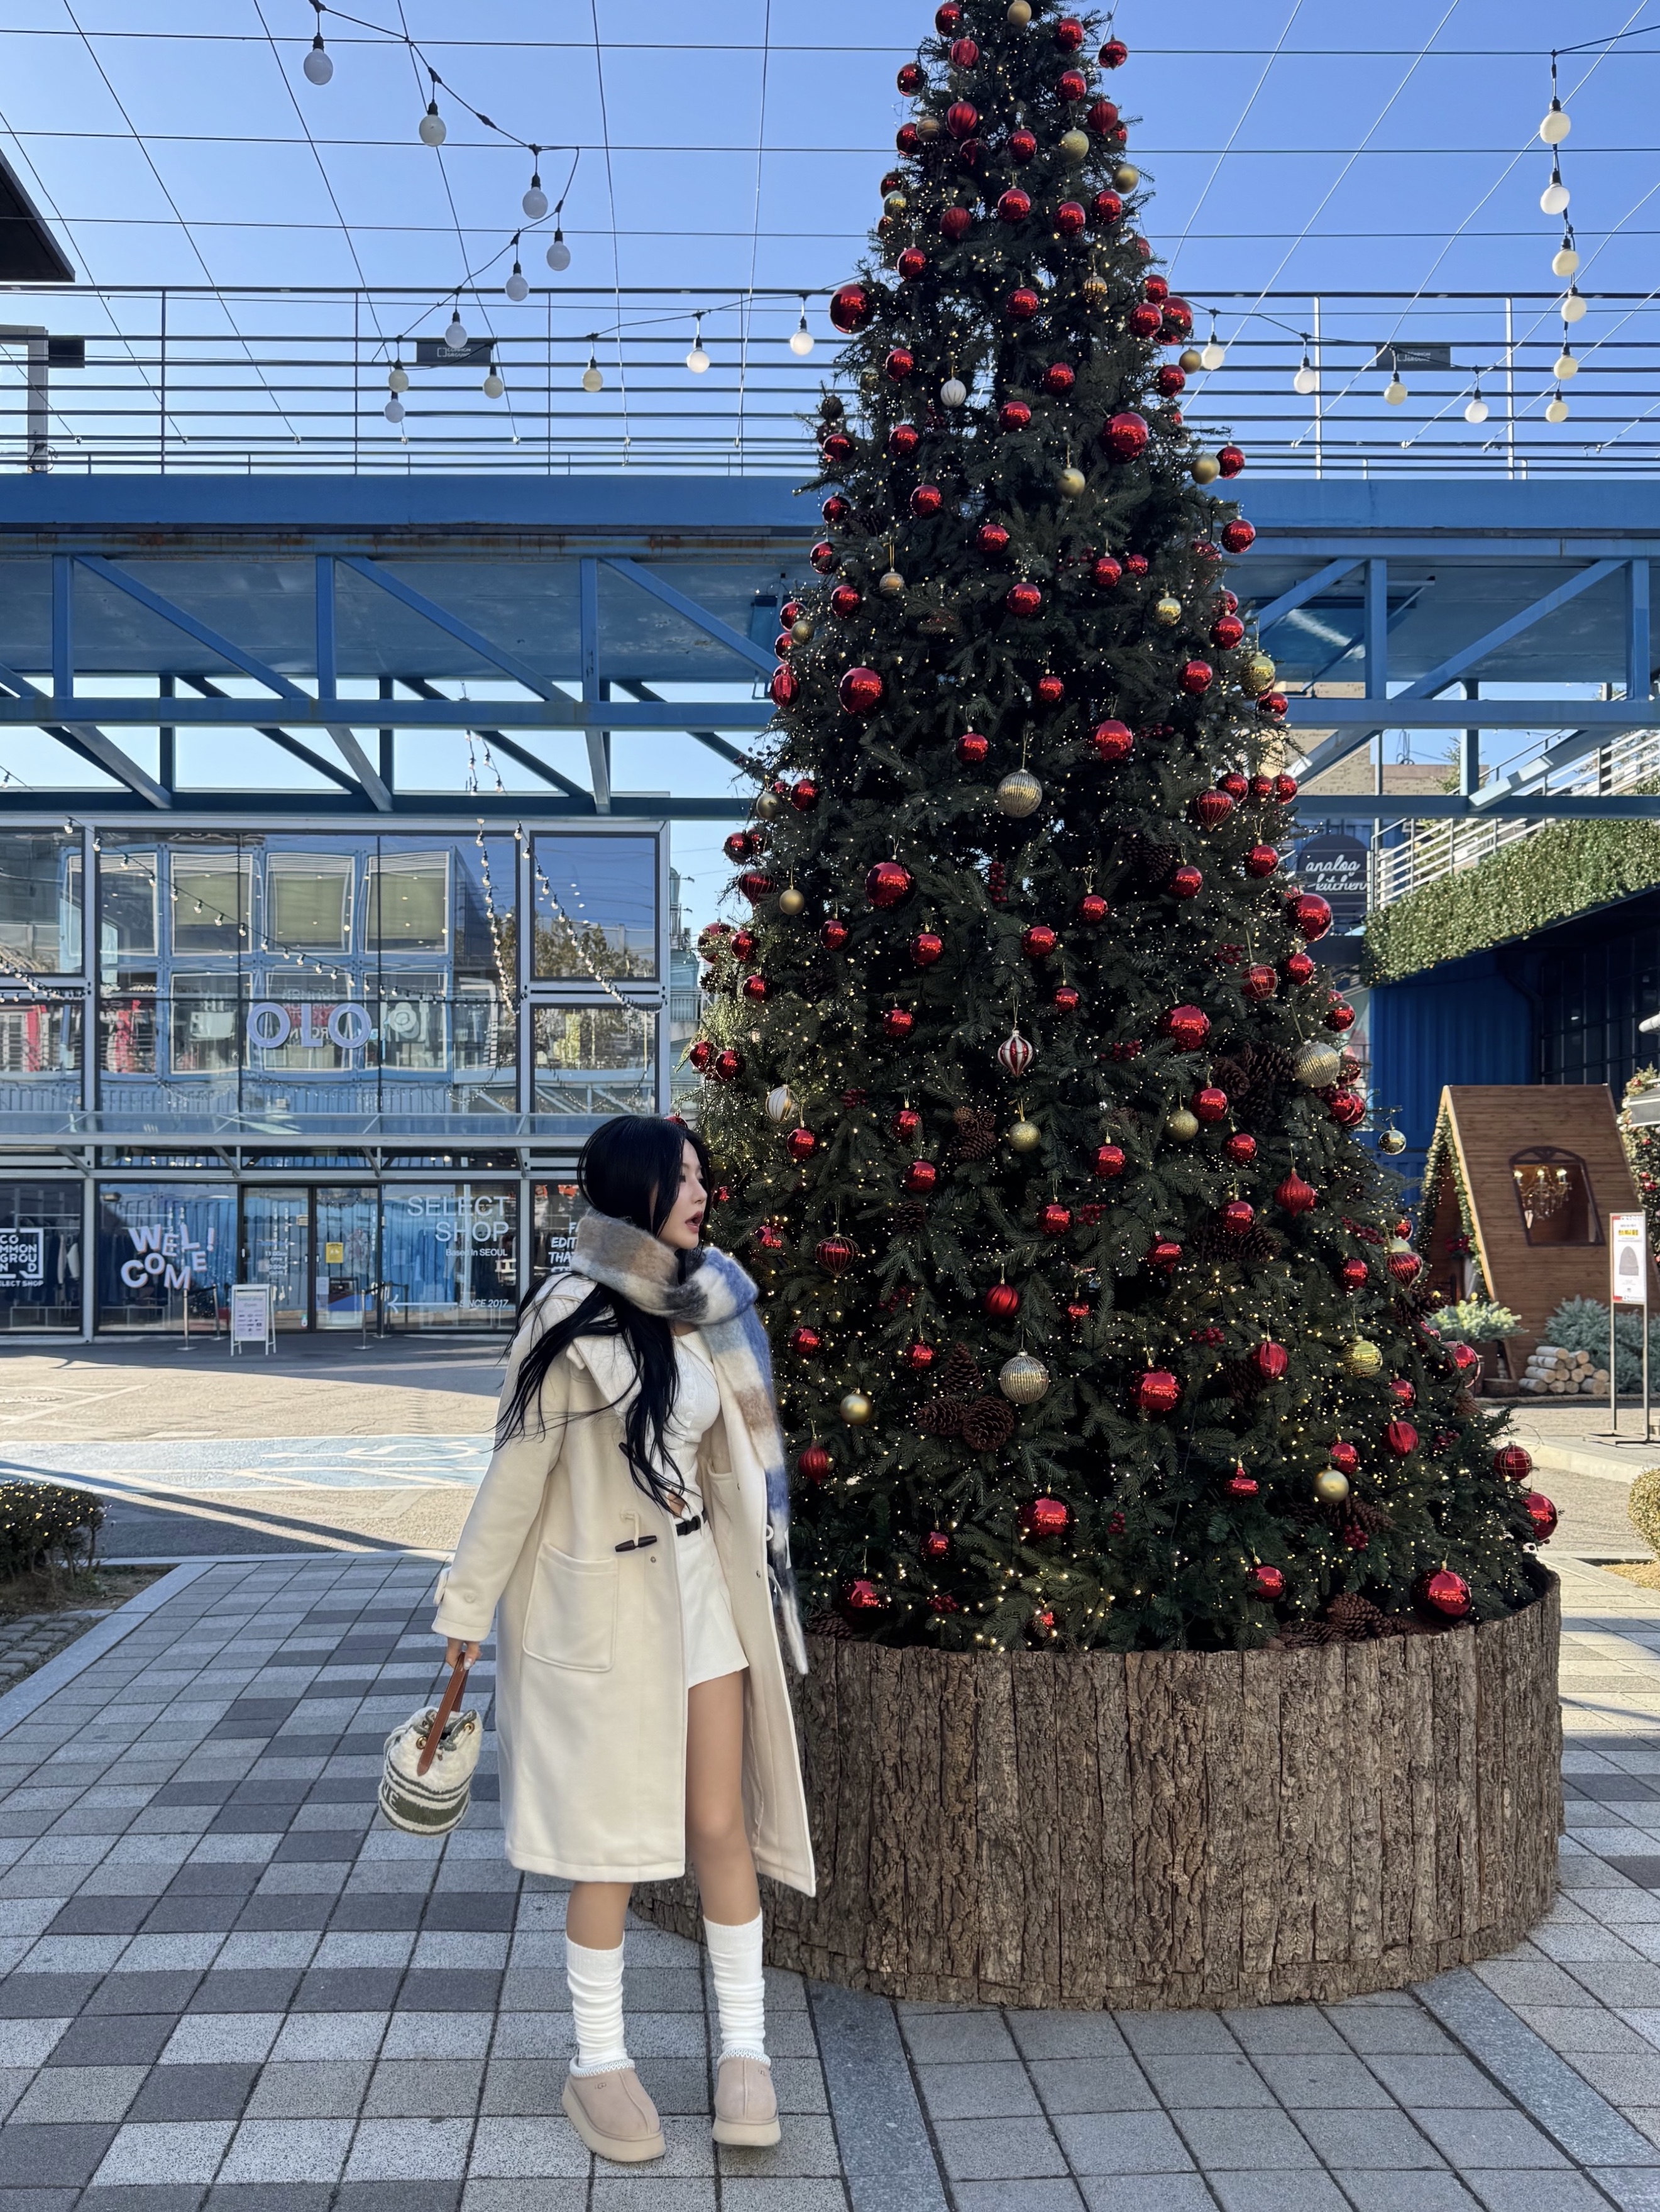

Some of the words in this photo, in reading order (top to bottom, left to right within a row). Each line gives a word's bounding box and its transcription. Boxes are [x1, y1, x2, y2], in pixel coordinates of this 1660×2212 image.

[1305, 854, 1361, 877] analog
[1307, 873, 1367, 892] kitchen
[246, 1002, 372, 1049] OLO
[407, 1196, 510, 1216] SELECT
[435, 1221, 509, 1242] SHOP
[480, 1248, 508, 1257] SEOUL
[488, 1299, 509, 1308] 2017
